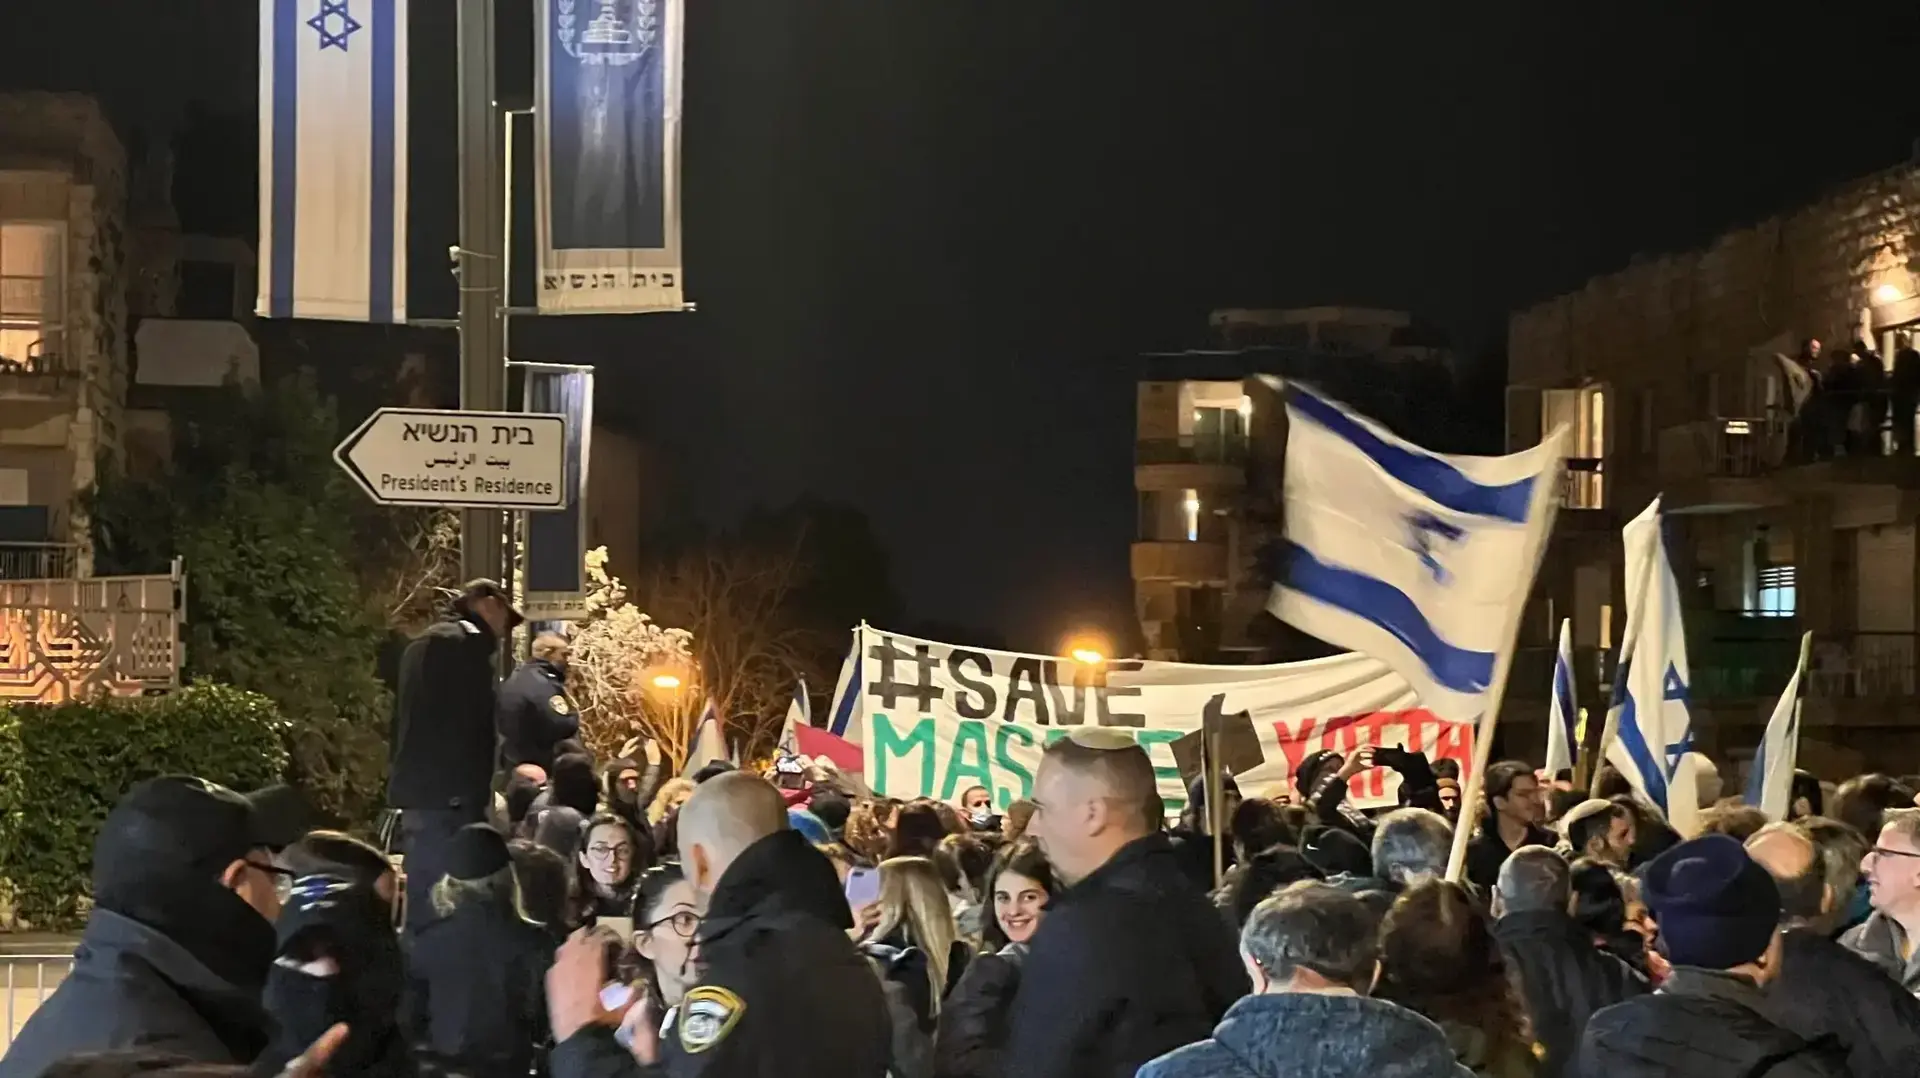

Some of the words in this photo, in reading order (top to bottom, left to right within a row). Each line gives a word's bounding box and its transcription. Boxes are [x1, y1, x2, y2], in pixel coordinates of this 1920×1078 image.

[543, 273, 616, 290] הנשיא
[632, 273, 675, 289] בית
[402, 422, 477, 443] הנשיא
[491, 425, 535, 445] בית
[485, 455, 511, 471] بيت
[381, 474, 468, 492] President's
[474, 477, 553, 495] Residence
[868, 637, 1145, 728] #SAVE
